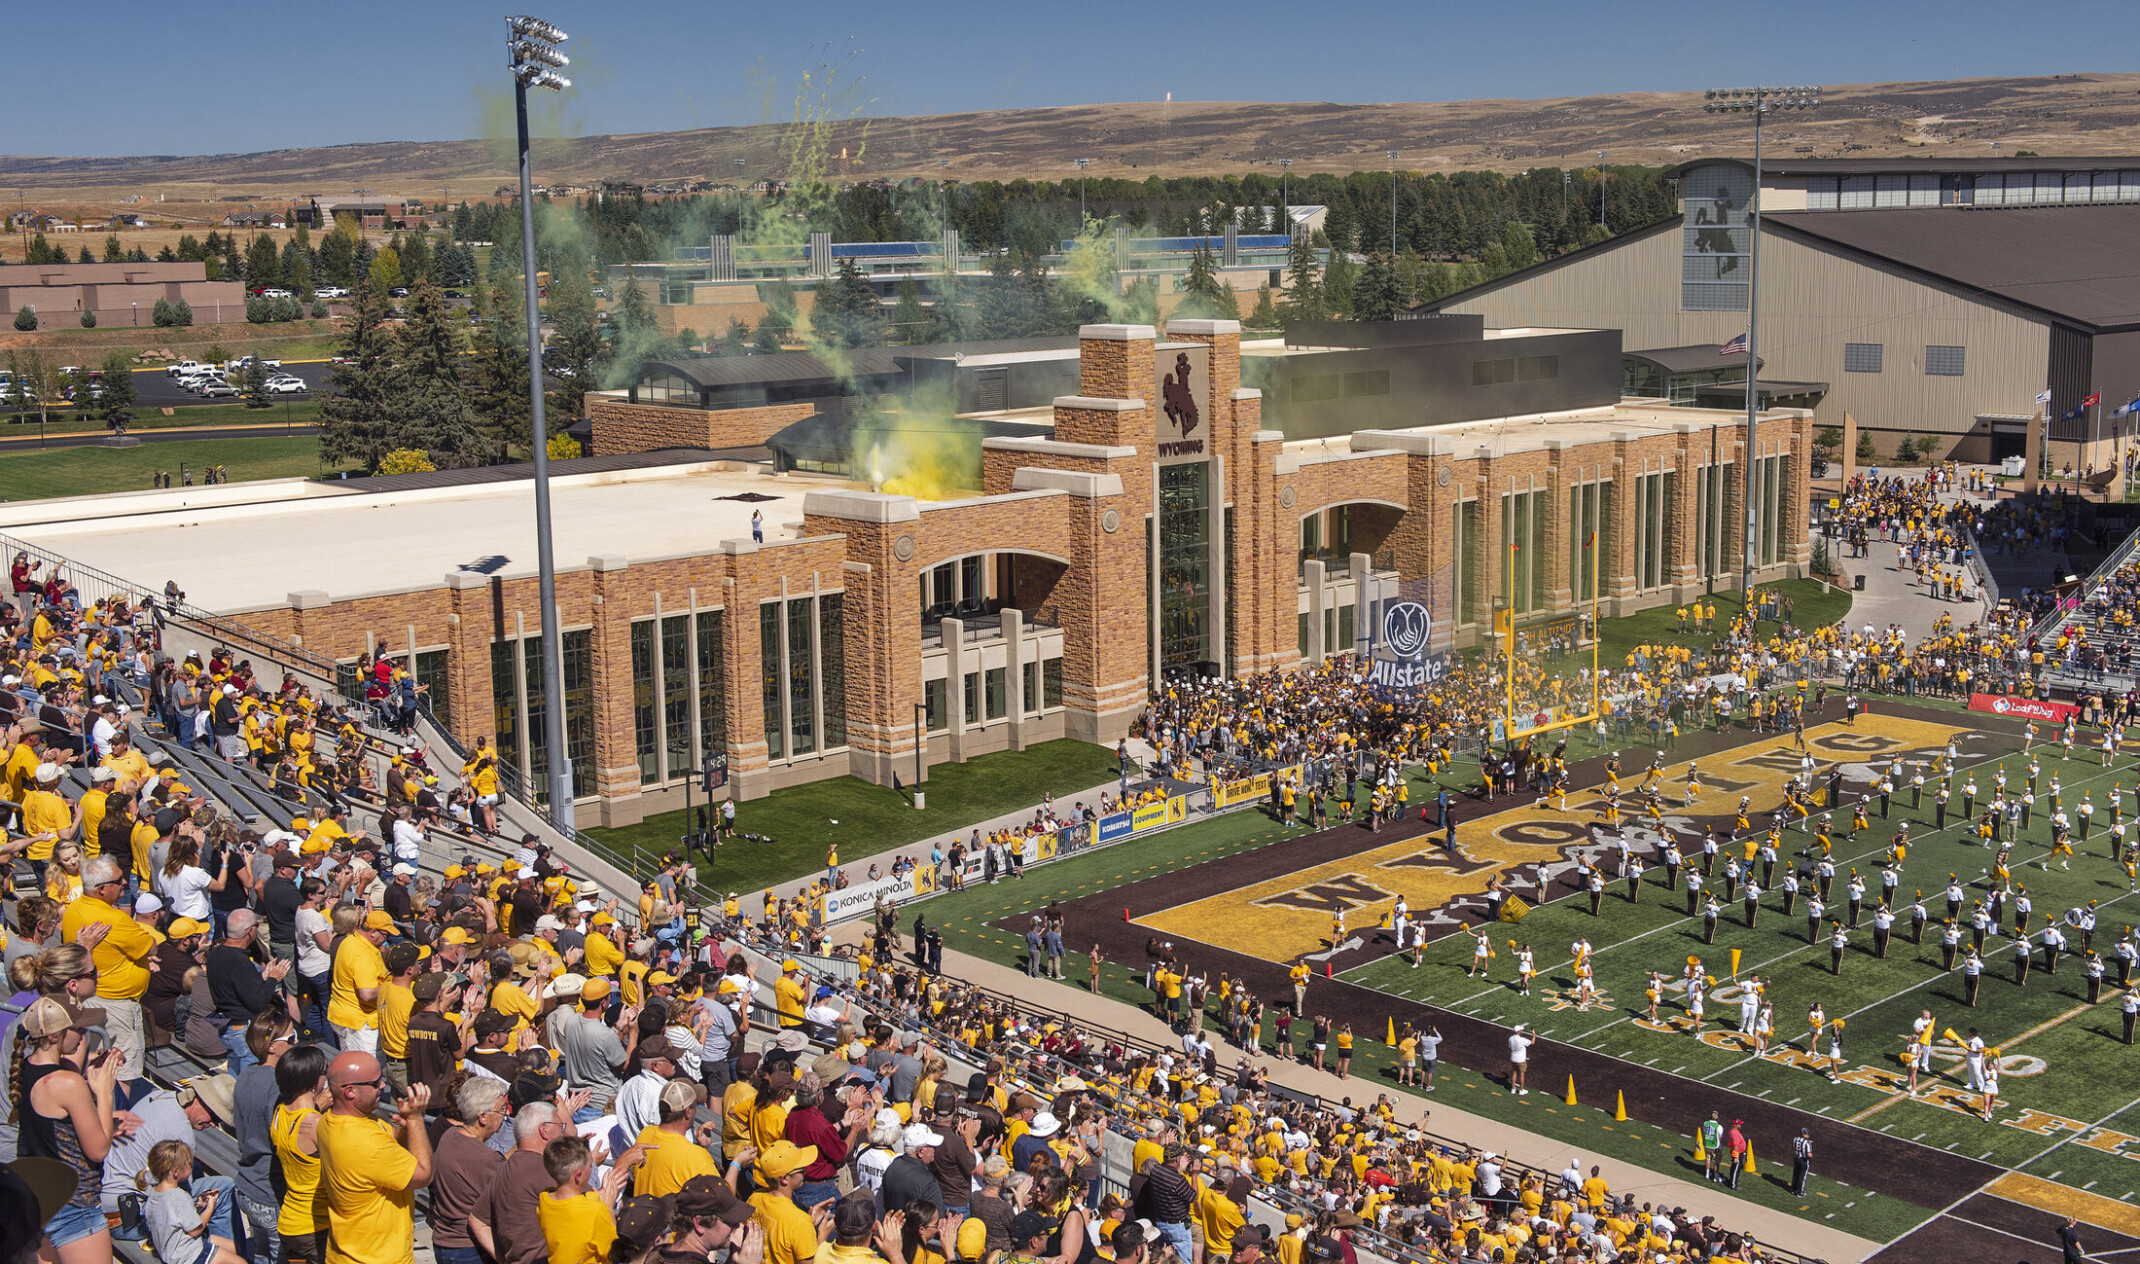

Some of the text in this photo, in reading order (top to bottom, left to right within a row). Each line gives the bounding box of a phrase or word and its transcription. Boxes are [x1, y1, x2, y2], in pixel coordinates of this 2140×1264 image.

[1158, 439, 1204, 457] WYOMING
[1368, 659, 1442, 688] Allstate
[2011, 702, 2032, 714] Loaf
[1518, 714, 1552, 730] WYOG
[1226, 786, 1240, 799] DRIVE
[1255, 779, 1267, 791] TEXT
[1134, 810, 1164, 824] EQUIPMENT
[1102, 819, 1131, 833] KOMATSU
[840, 880, 913, 909] KONICA MINOLTA
[687, 915, 699, 927] 21
[2000, 1107, 2140, 1162] FI
